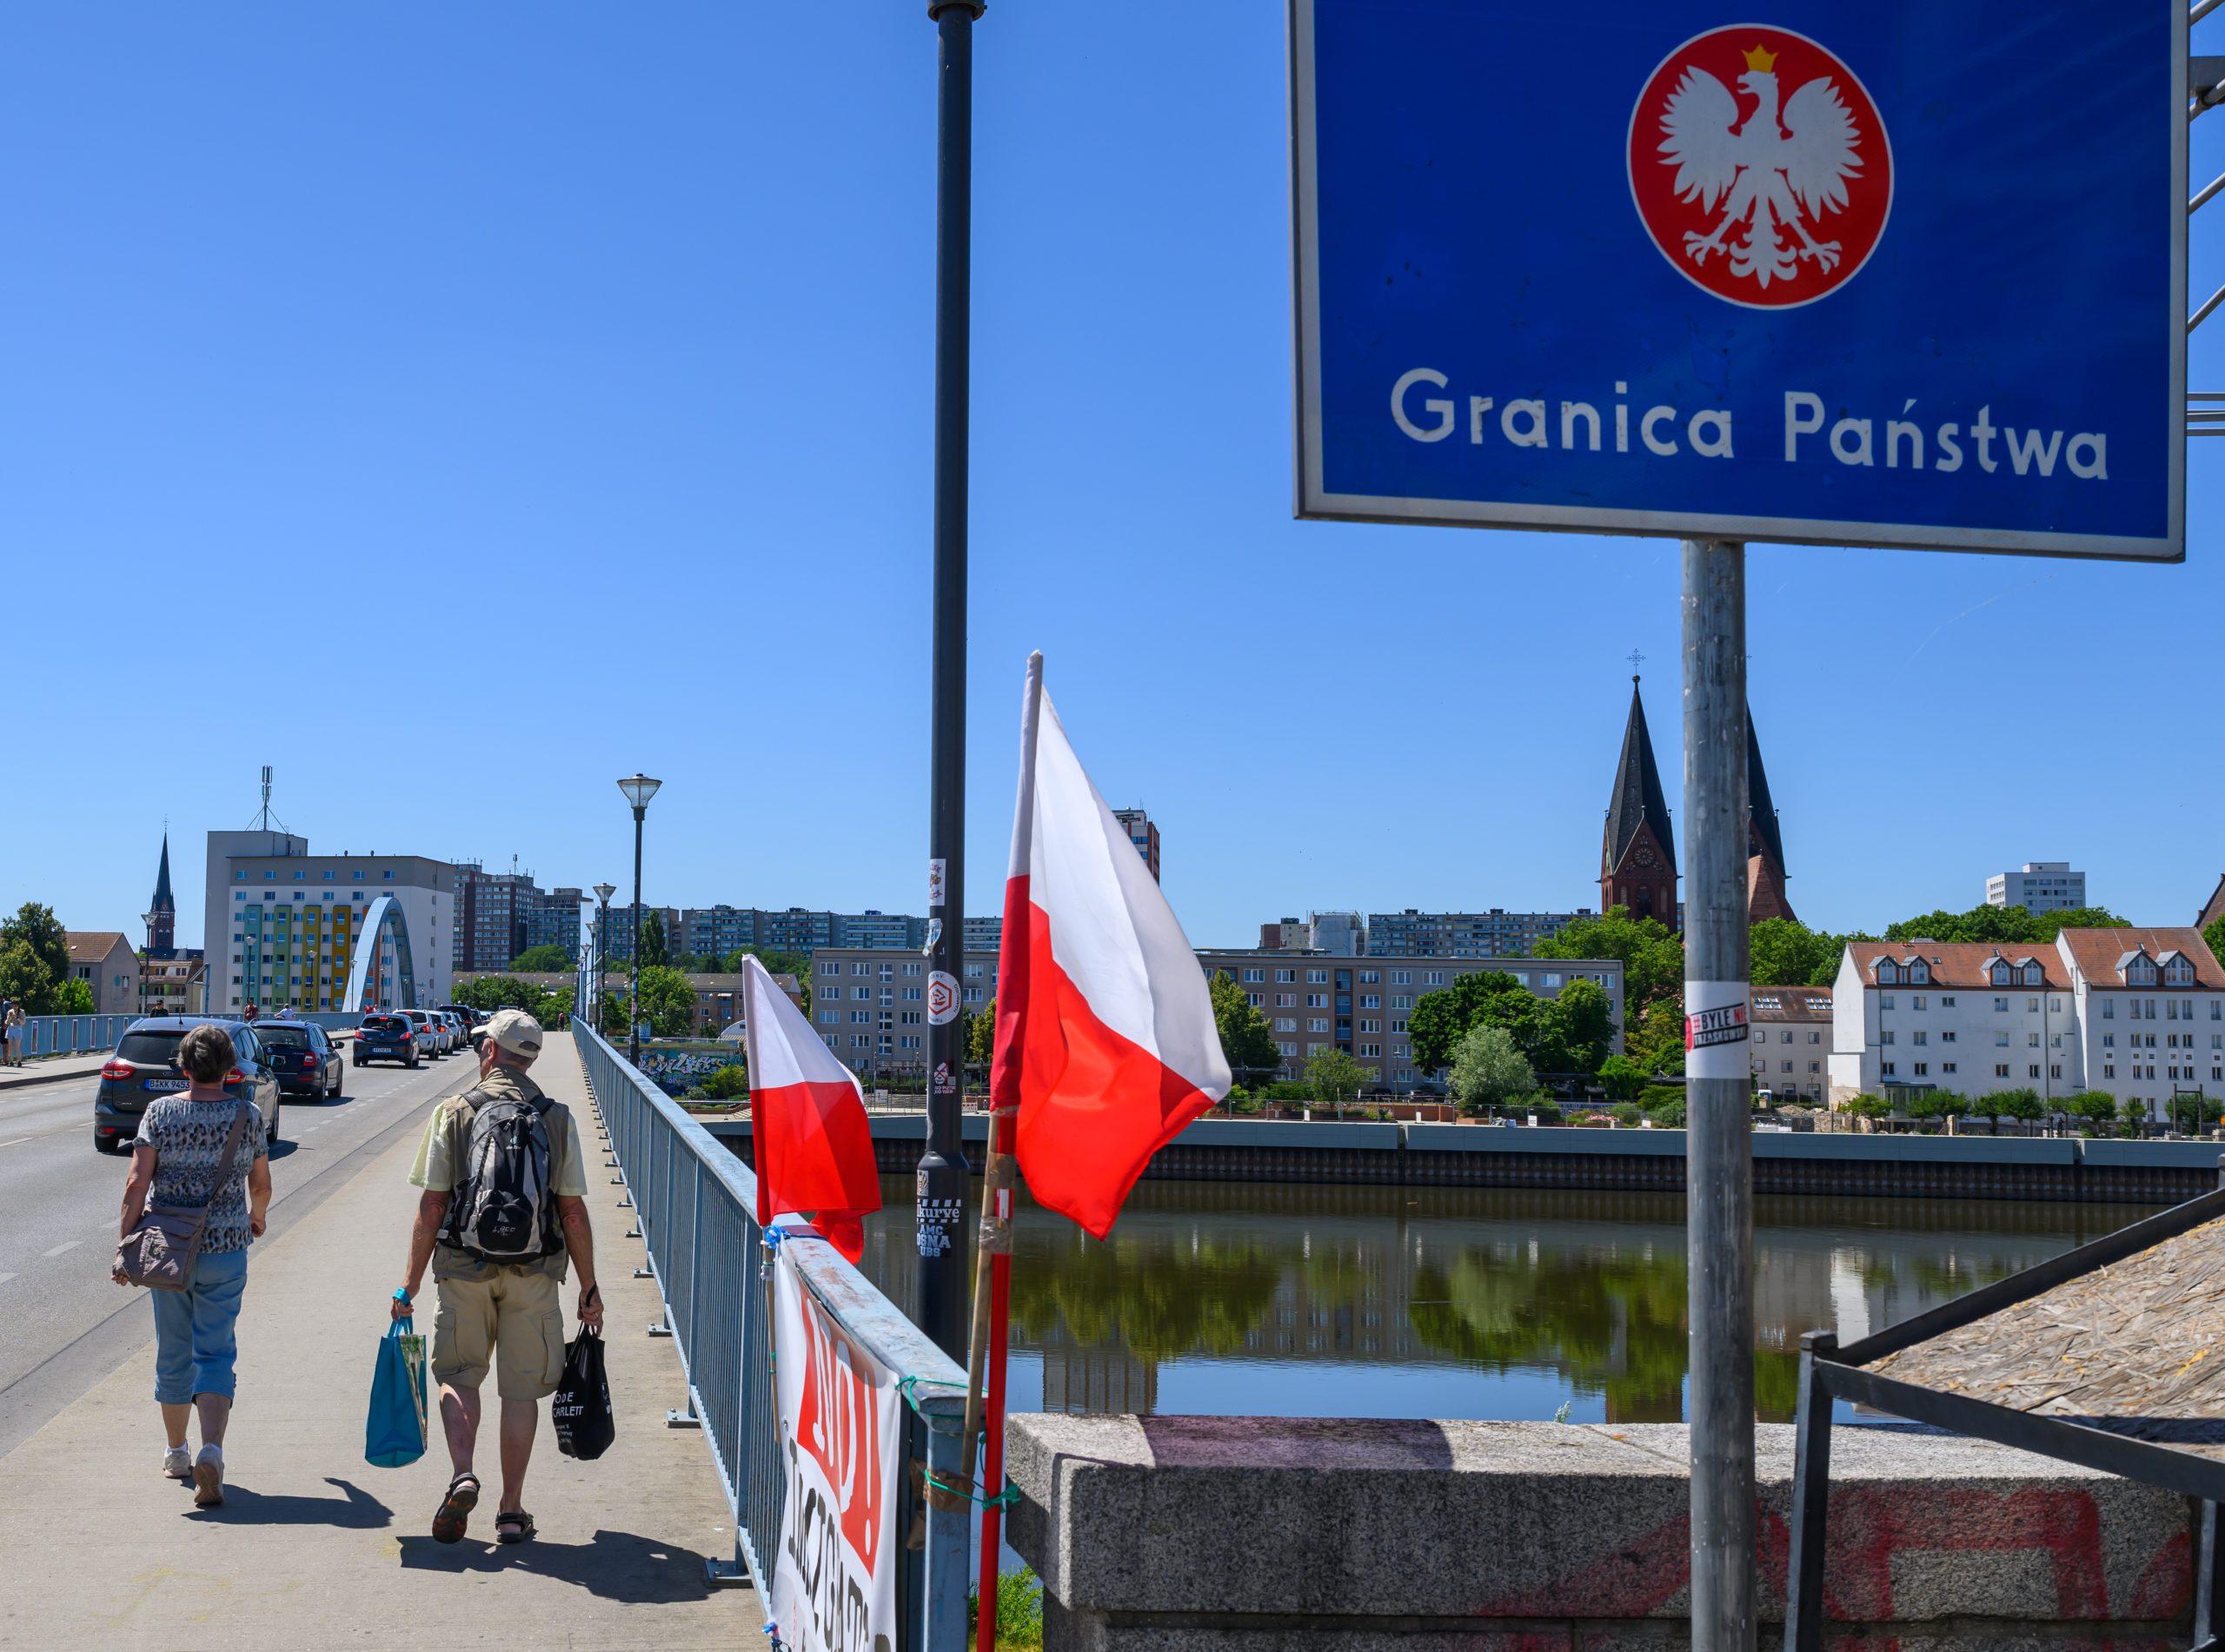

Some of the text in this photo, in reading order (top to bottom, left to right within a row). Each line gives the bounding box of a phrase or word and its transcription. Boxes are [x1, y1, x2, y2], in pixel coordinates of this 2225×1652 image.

[1391, 367, 2109, 481] Granica Państwa
[1694, 1010, 1730, 1032] #BYLE
[149, 1079, 155, 1088] B
[920, 1224, 944, 1236] AMC
[917, 1233, 952, 1249] OSNA
